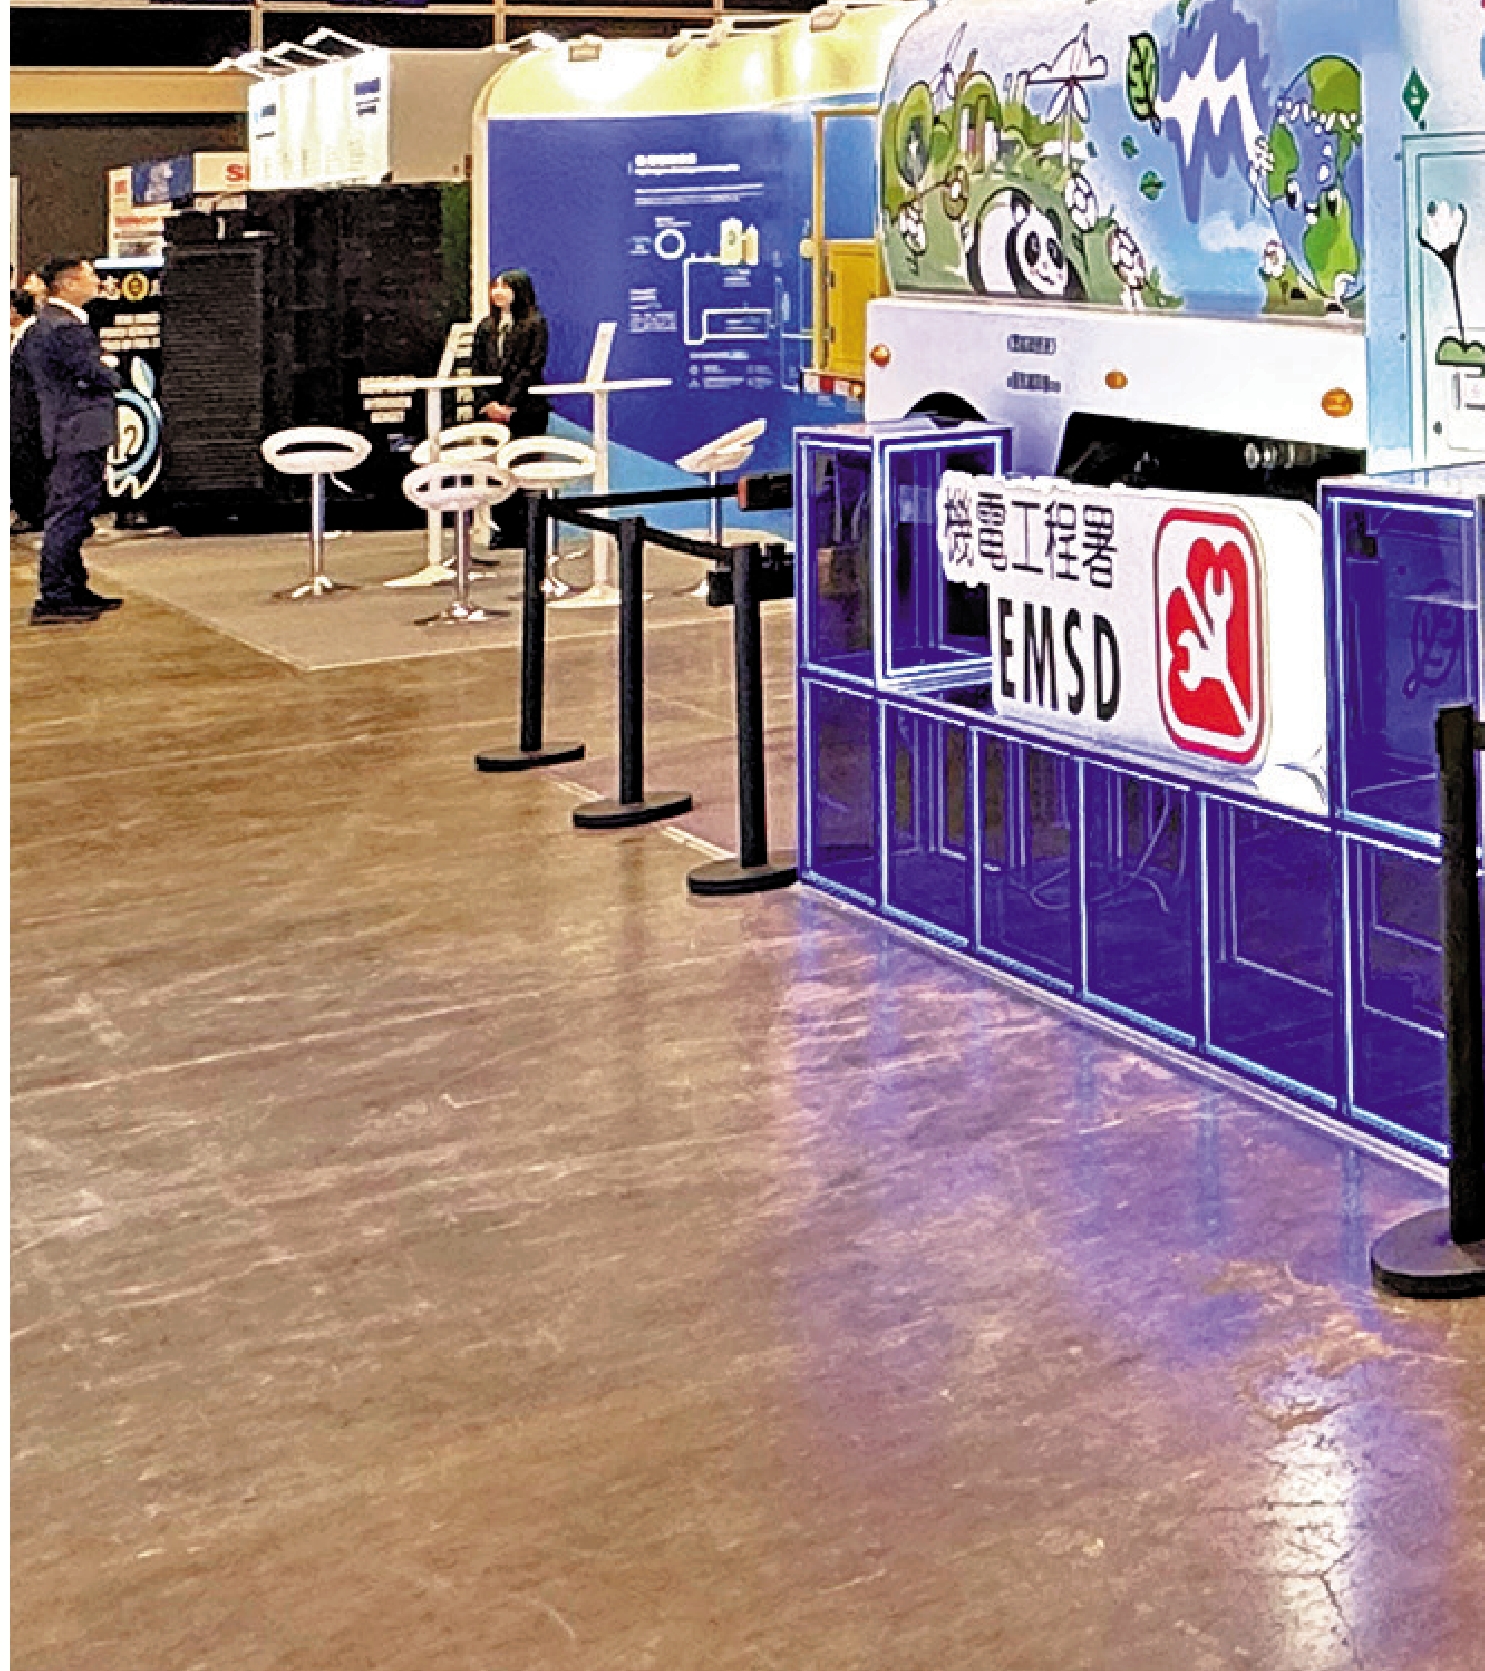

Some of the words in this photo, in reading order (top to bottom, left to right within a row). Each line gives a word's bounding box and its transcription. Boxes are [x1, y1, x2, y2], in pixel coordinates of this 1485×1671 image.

[943, 485, 1118, 589] 機電工程署
[997, 596, 1121, 722] EMSD
